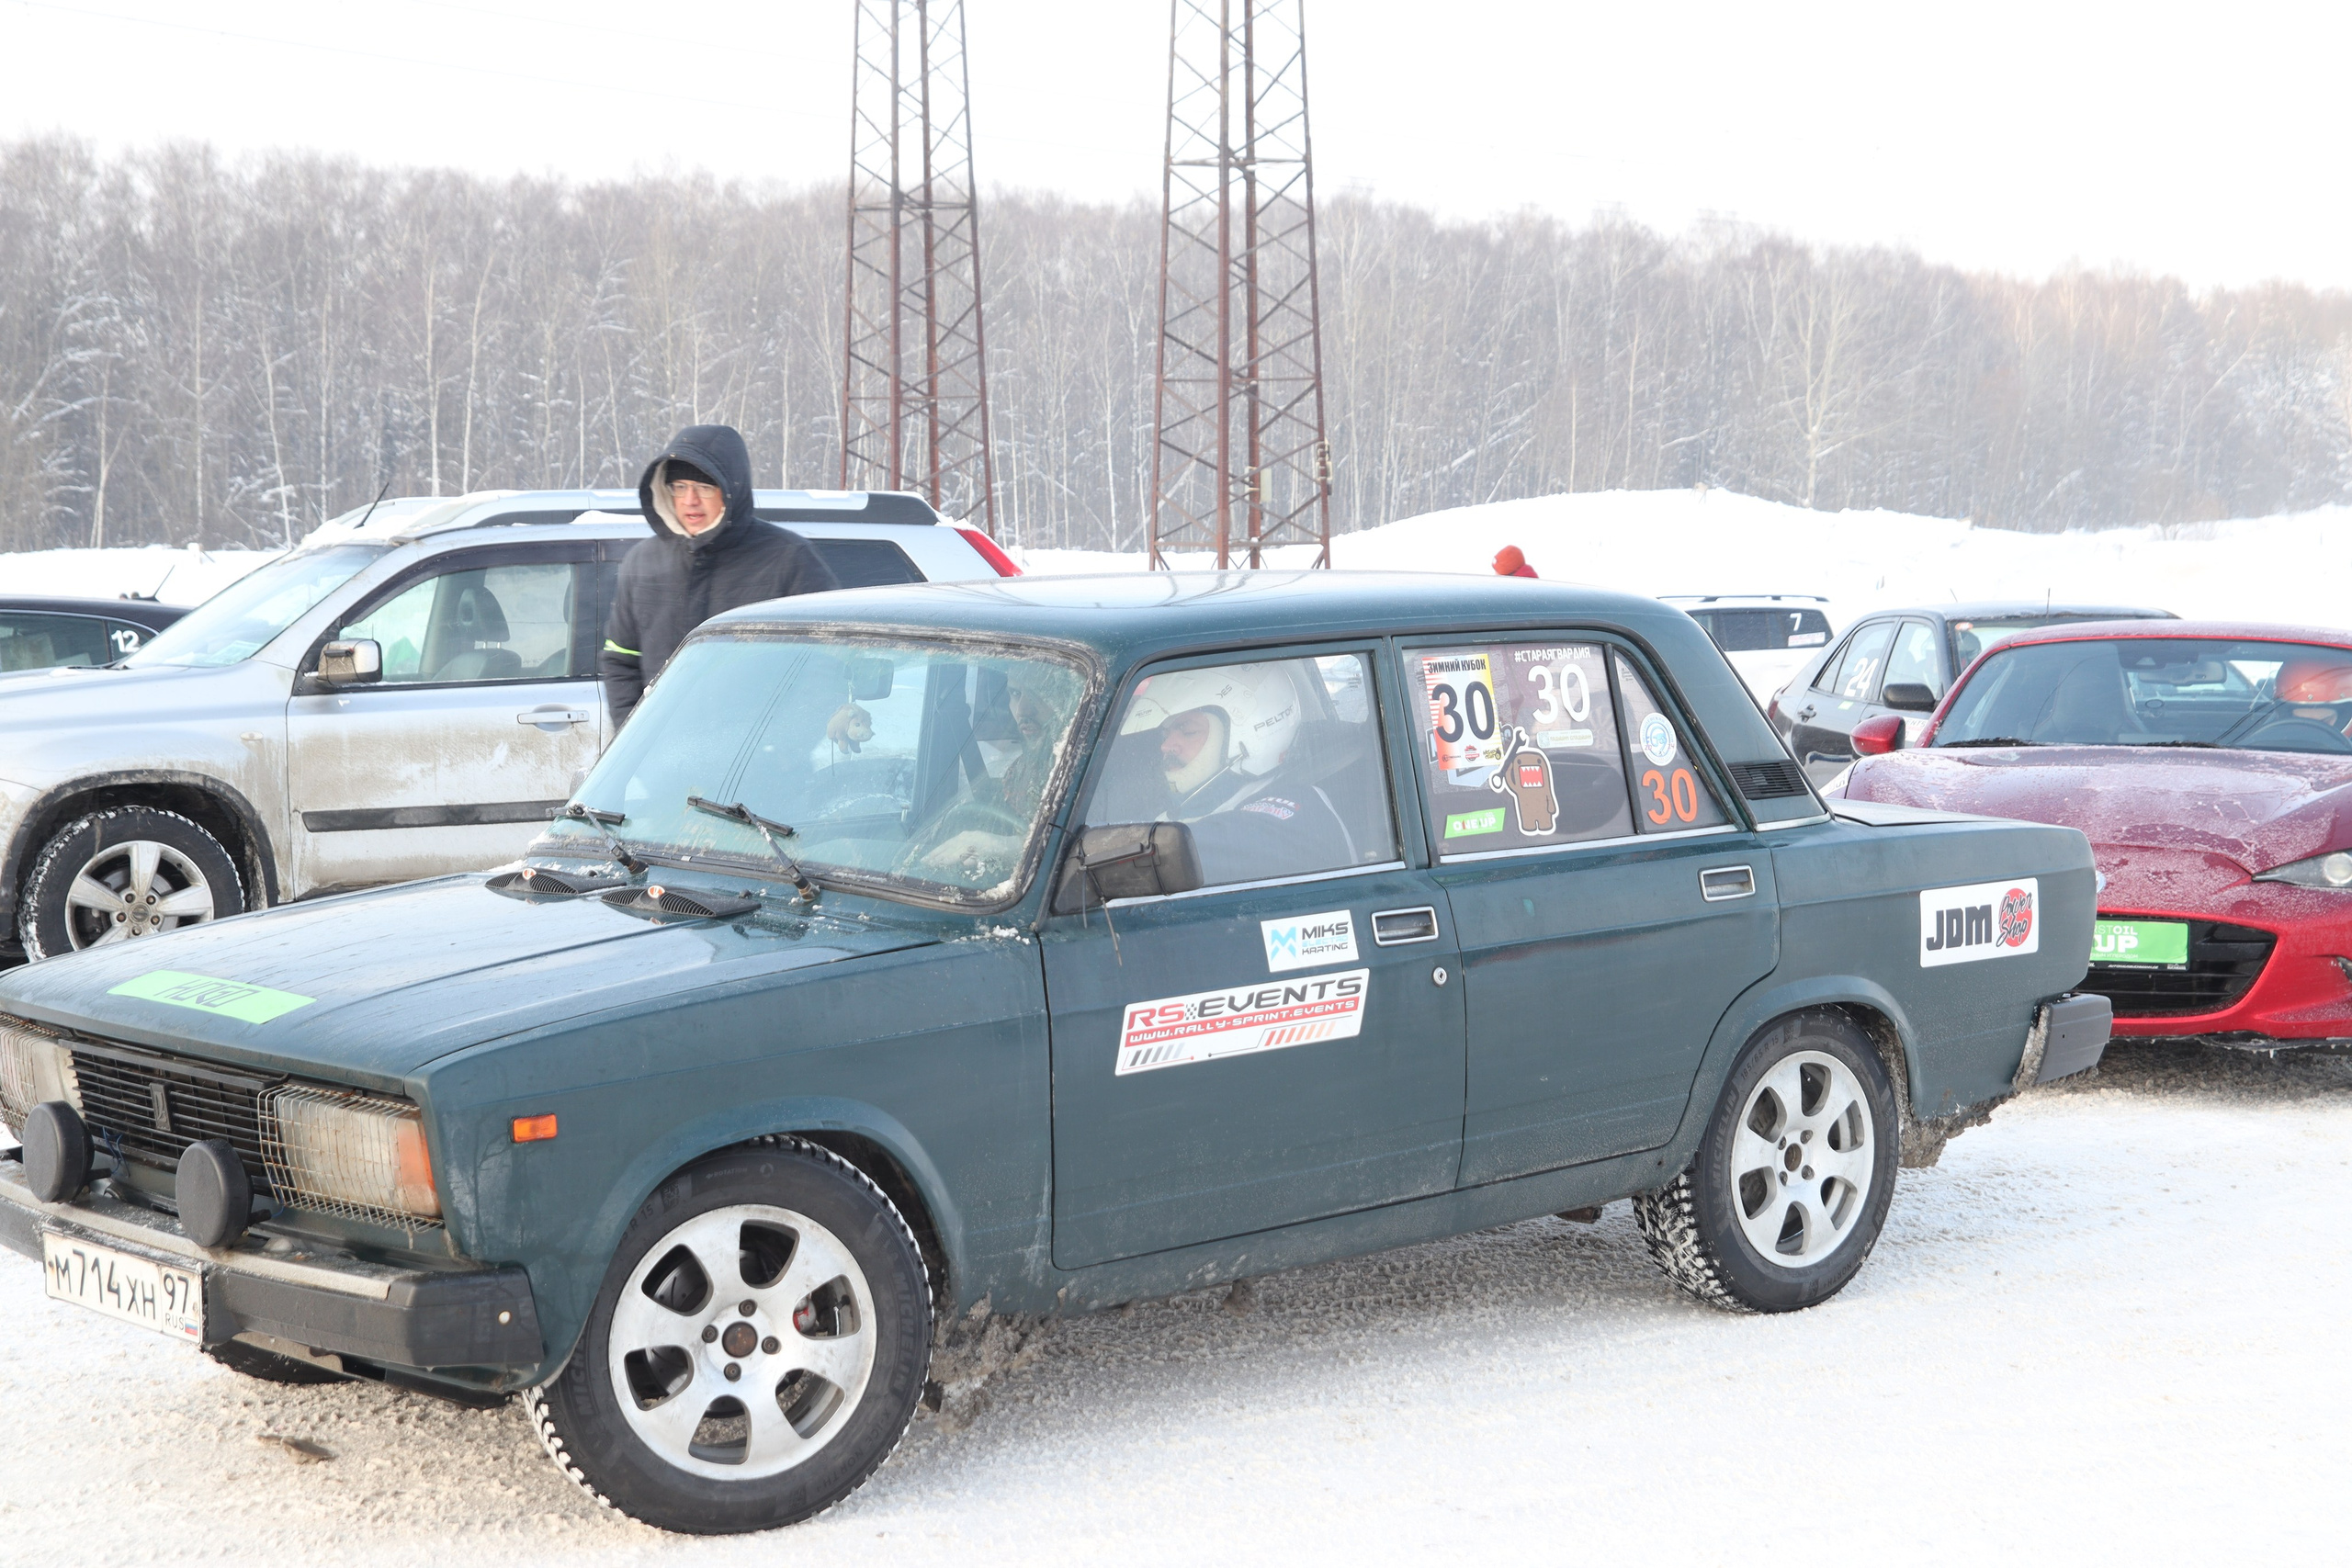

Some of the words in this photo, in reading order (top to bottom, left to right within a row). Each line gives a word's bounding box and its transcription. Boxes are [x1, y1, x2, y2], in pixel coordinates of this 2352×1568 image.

[1789, 612, 1803, 632] 7
[111, 629, 140, 653] 12
[1514, 647, 1591, 662] #СТАРАЯГВАРДИЯ
[1427, 659, 1461, 673] ЗИМНИЙ
[1461, 659, 1487, 671] КУБОК
[1844, 657, 1879, 698] 24
[1528, 663, 1591, 725] 30
[1432, 681, 1495, 743] 30
[1642, 768, 1698, 825] 30
[1479, 817, 1496, 828] UP
[1998, 891, 2033, 924] Power
[1302, 921, 1349, 941] MIKS
[1302, 935, 1349, 948] ELECTRO
[1926, 904, 1992, 952] JDM
[1996, 913, 2029, 948] Shop
[1302, 942, 1349, 955] KARTING
[1197, 976, 1363, 1018] EVENTS
[1713, 1089, 1737, 1189] MICHELIN
[54, 1248, 156, 1321] М714ХН
[163, 1272, 189, 1314] 97
[164, 1312, 184, 1331] RUS
